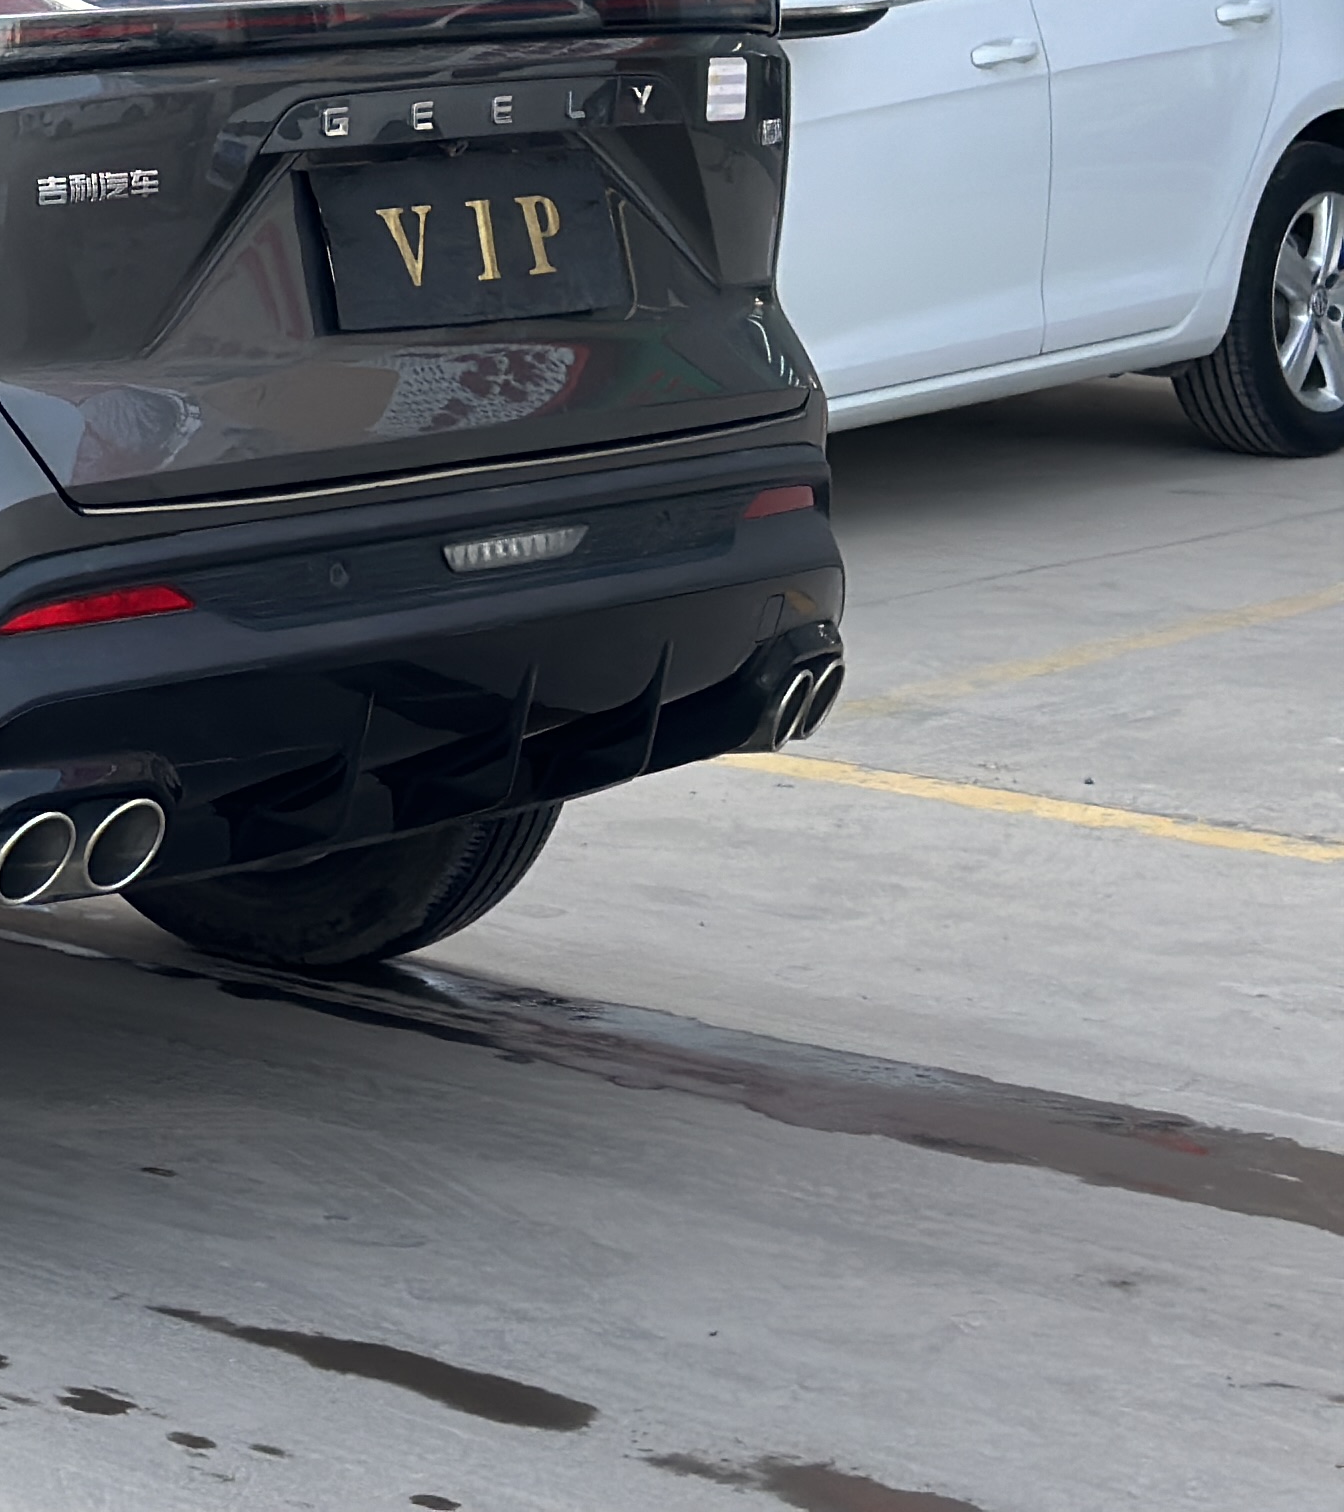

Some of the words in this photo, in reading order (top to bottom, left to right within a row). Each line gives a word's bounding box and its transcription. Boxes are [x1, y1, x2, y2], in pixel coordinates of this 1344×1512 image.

[322, 83, 654, 137] GEELY
[36, 169, 160, 207] 吉利汽车
